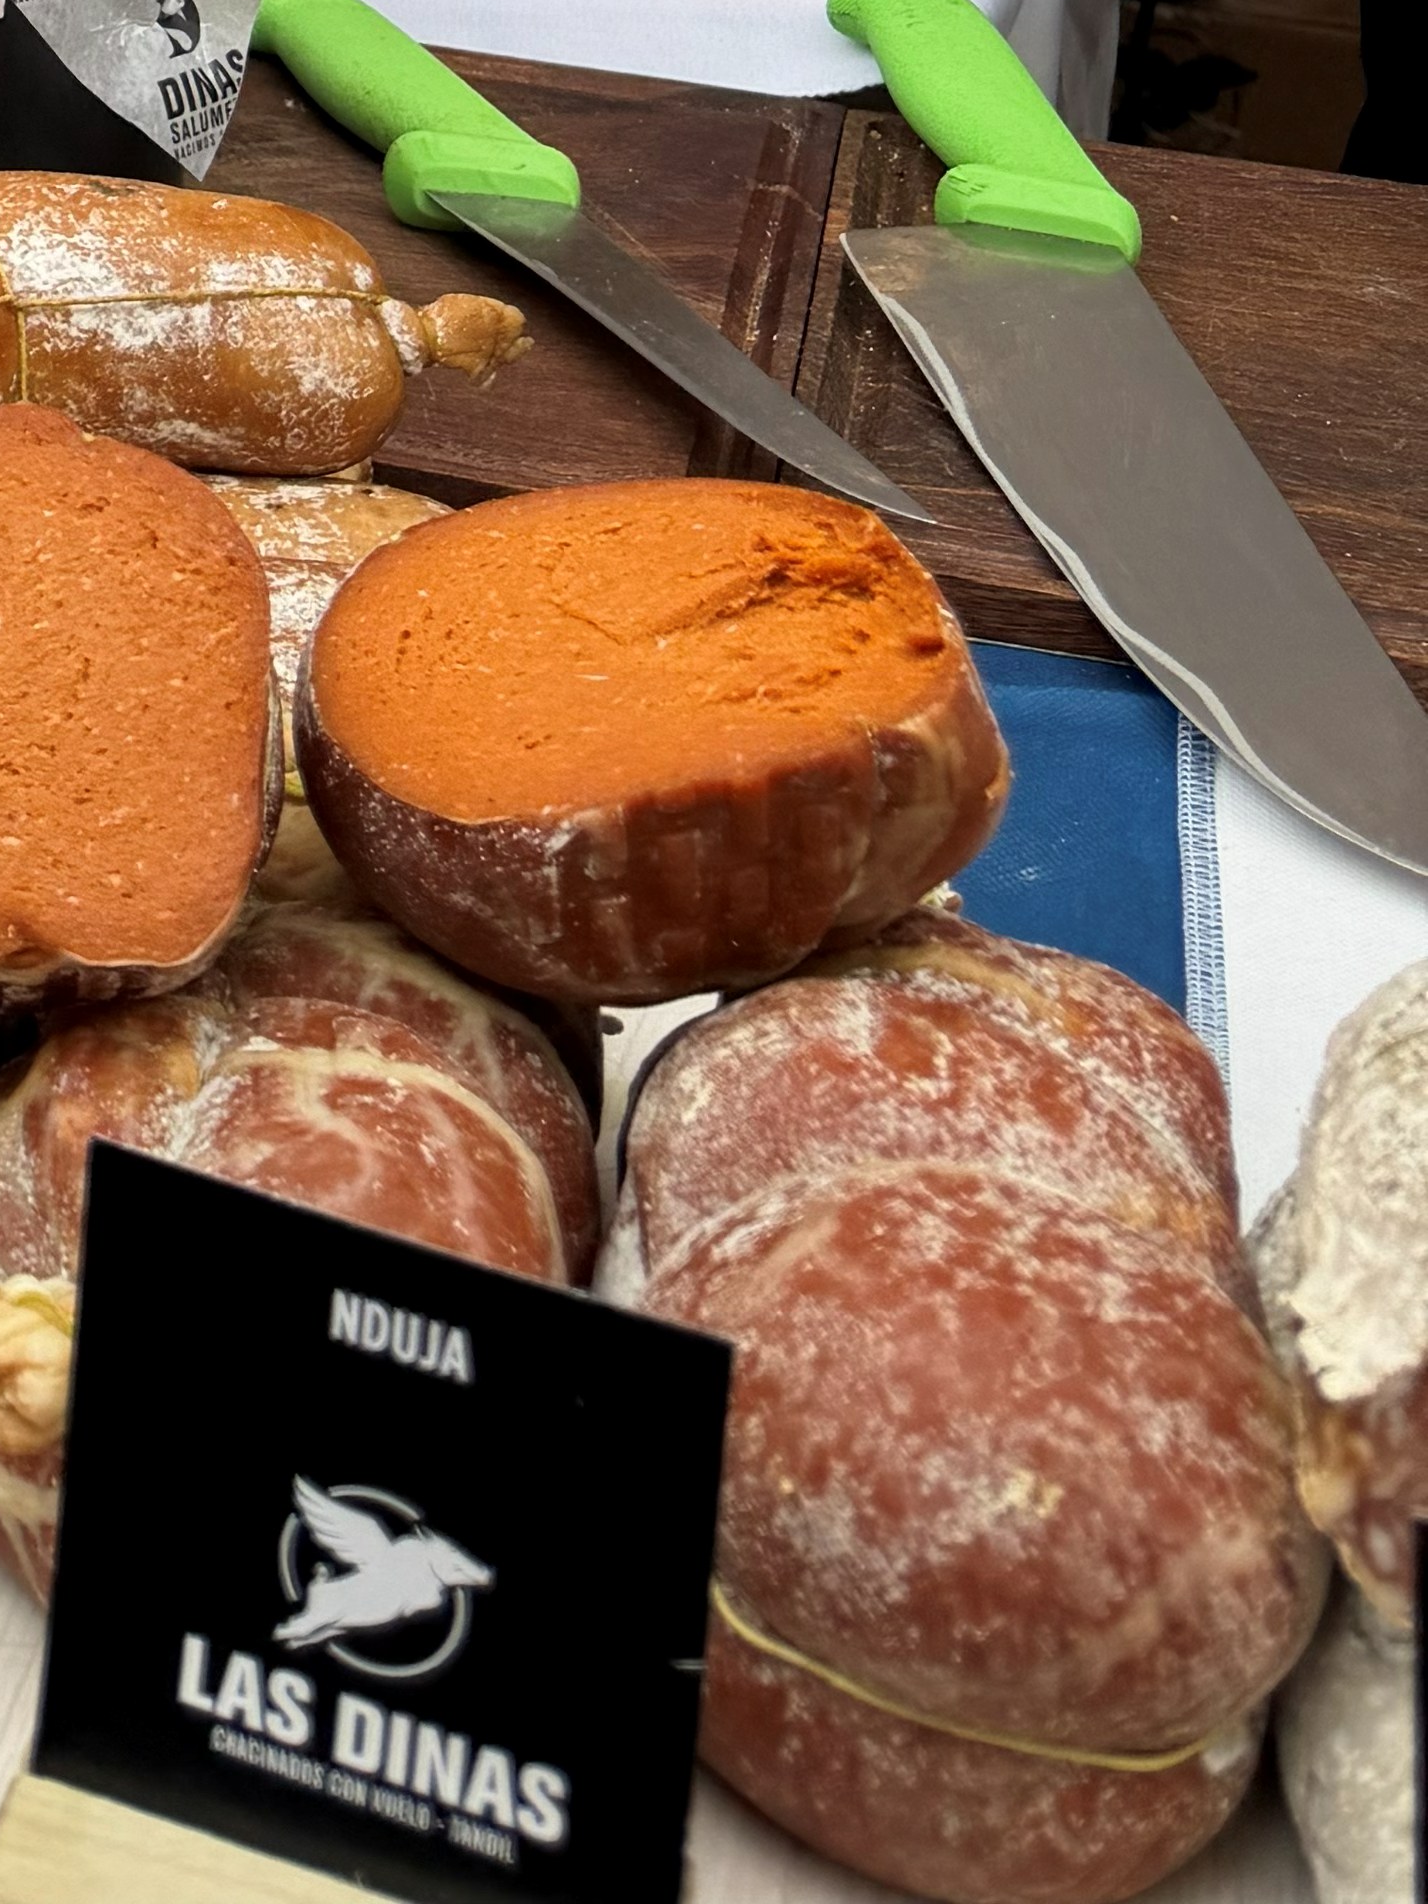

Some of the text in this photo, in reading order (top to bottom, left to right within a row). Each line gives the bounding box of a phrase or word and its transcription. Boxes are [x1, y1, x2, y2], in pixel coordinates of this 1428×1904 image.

[170, 98, 235, 144] SALUME
[329, 1288, 475, 1386] NDUJA
[176, 1632, 571, 1846] LAS DINAS
